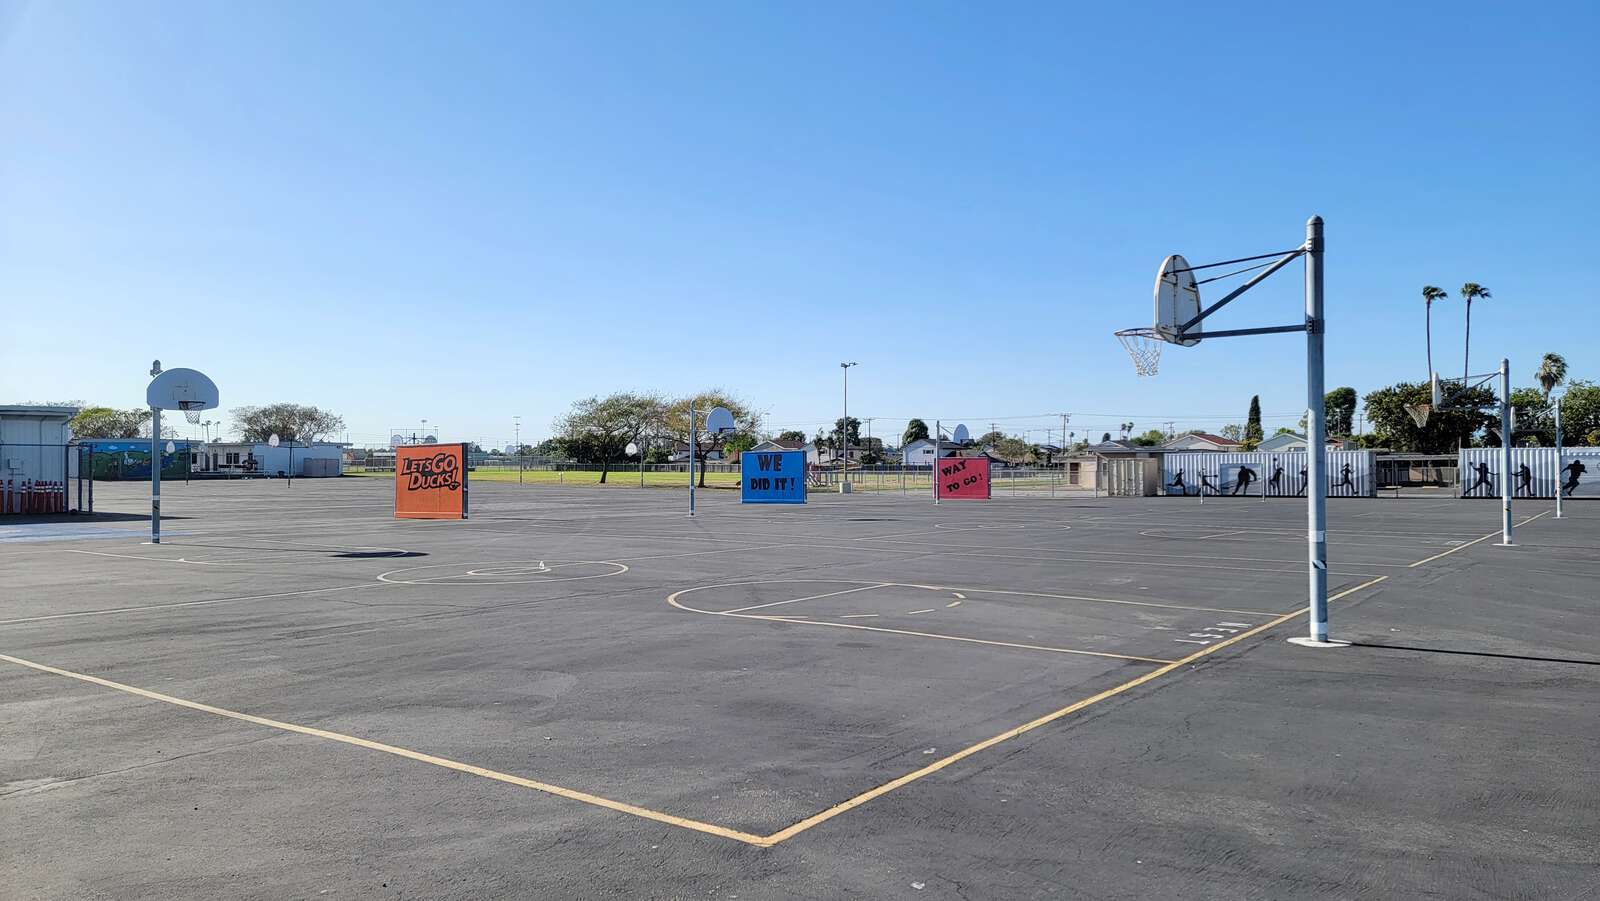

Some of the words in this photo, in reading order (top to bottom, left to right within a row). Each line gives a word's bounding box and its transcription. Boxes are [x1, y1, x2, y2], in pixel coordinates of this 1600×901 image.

[432, 453, 457, 473] GO
[757, 454, 782, 472] WE
[941, 459, 967, 477] WAY
[751, 478, 770, 490] DID
[946, 482, 960, 492] TO
